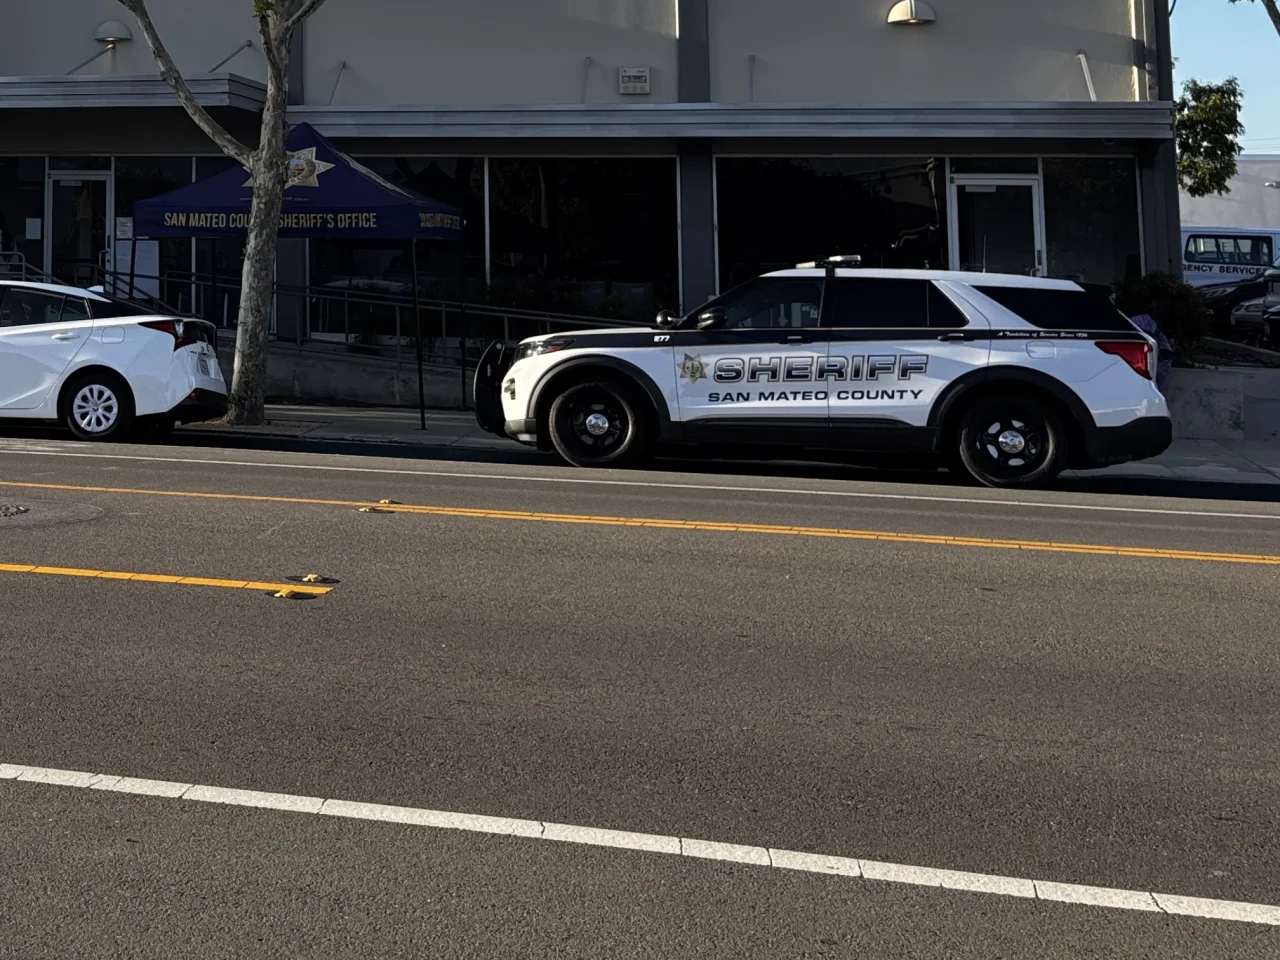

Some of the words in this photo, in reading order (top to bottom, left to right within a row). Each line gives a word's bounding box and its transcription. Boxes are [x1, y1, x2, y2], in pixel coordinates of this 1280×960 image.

[164, 212, 186, 227] SAN
[188, 212, 226, 227] MATEO
[279, 213, 334, 228] SHERIFF'S
[337, 212, 377, 228] OFFICE
[713, 354, 929, 384] SHERIFF
[708, 391, 751, 403] SAN
[758, 390, 828, 402] MATEO
[836, 389, 924, 401] COUNTY
